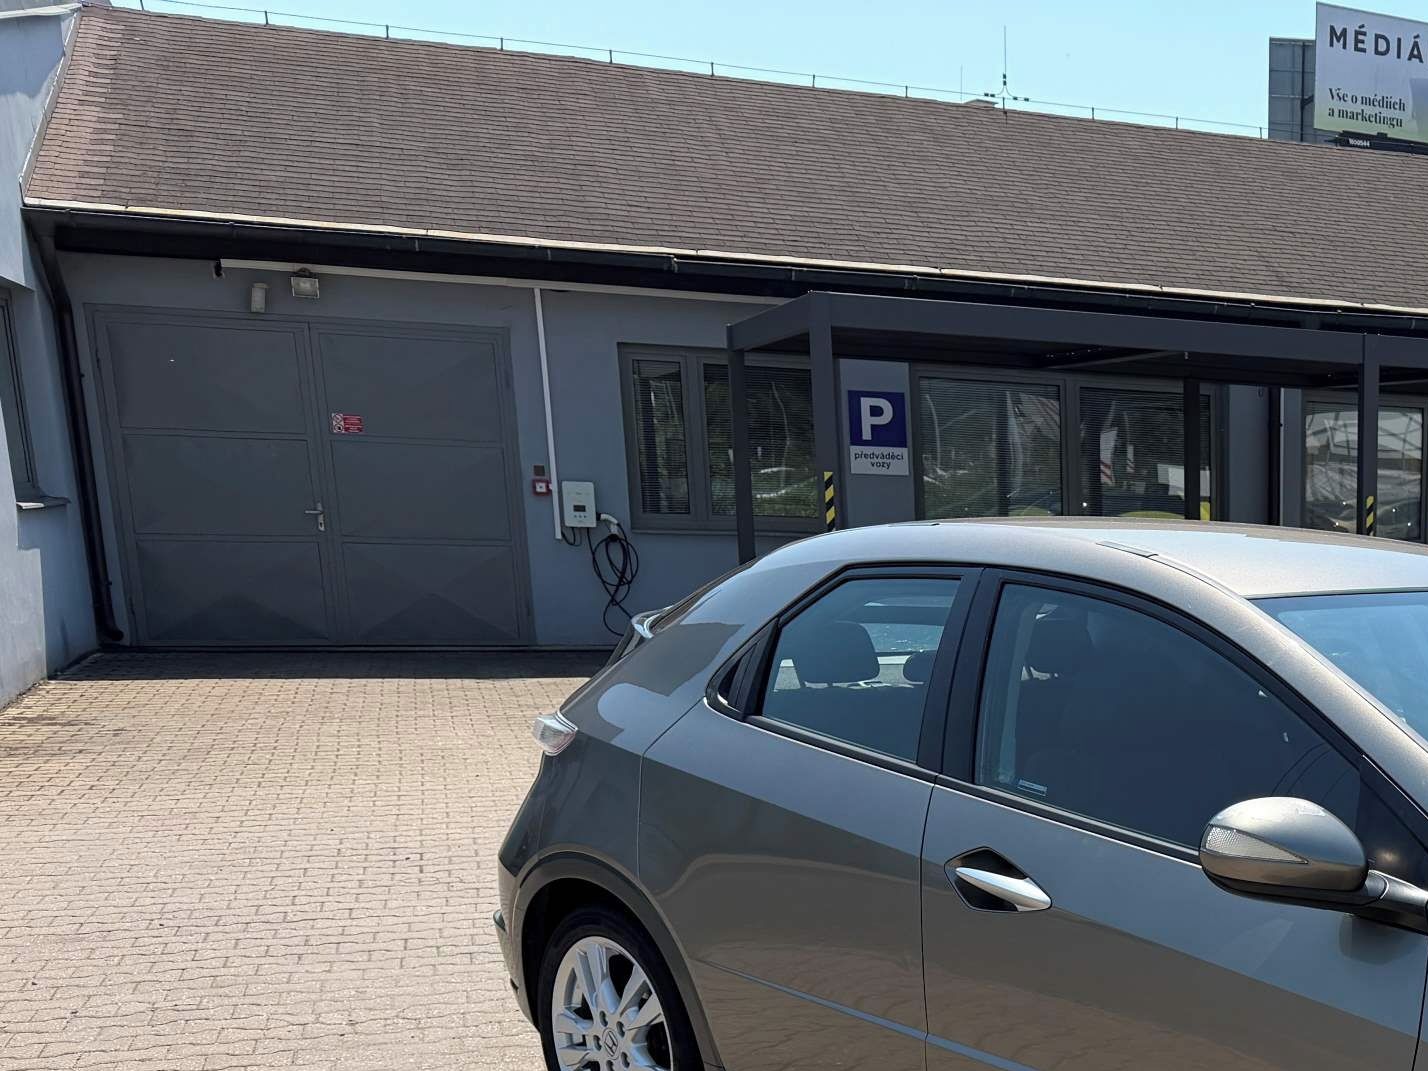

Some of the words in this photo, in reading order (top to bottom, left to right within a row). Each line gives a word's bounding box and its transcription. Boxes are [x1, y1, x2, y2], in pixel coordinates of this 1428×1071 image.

[1328, 88, 1349, 102] Vše
[1351, 94, 1358, 105] o
[1361, 93, 1406, 112] médiích
[1328, 107, 1335, 117] a
[1338, 108, 1403, 128] marketingu
[861, 397, 893, 440] P
[854, 451, 904, 461] předváděcí
[870, 461, 891, 469] vozy
